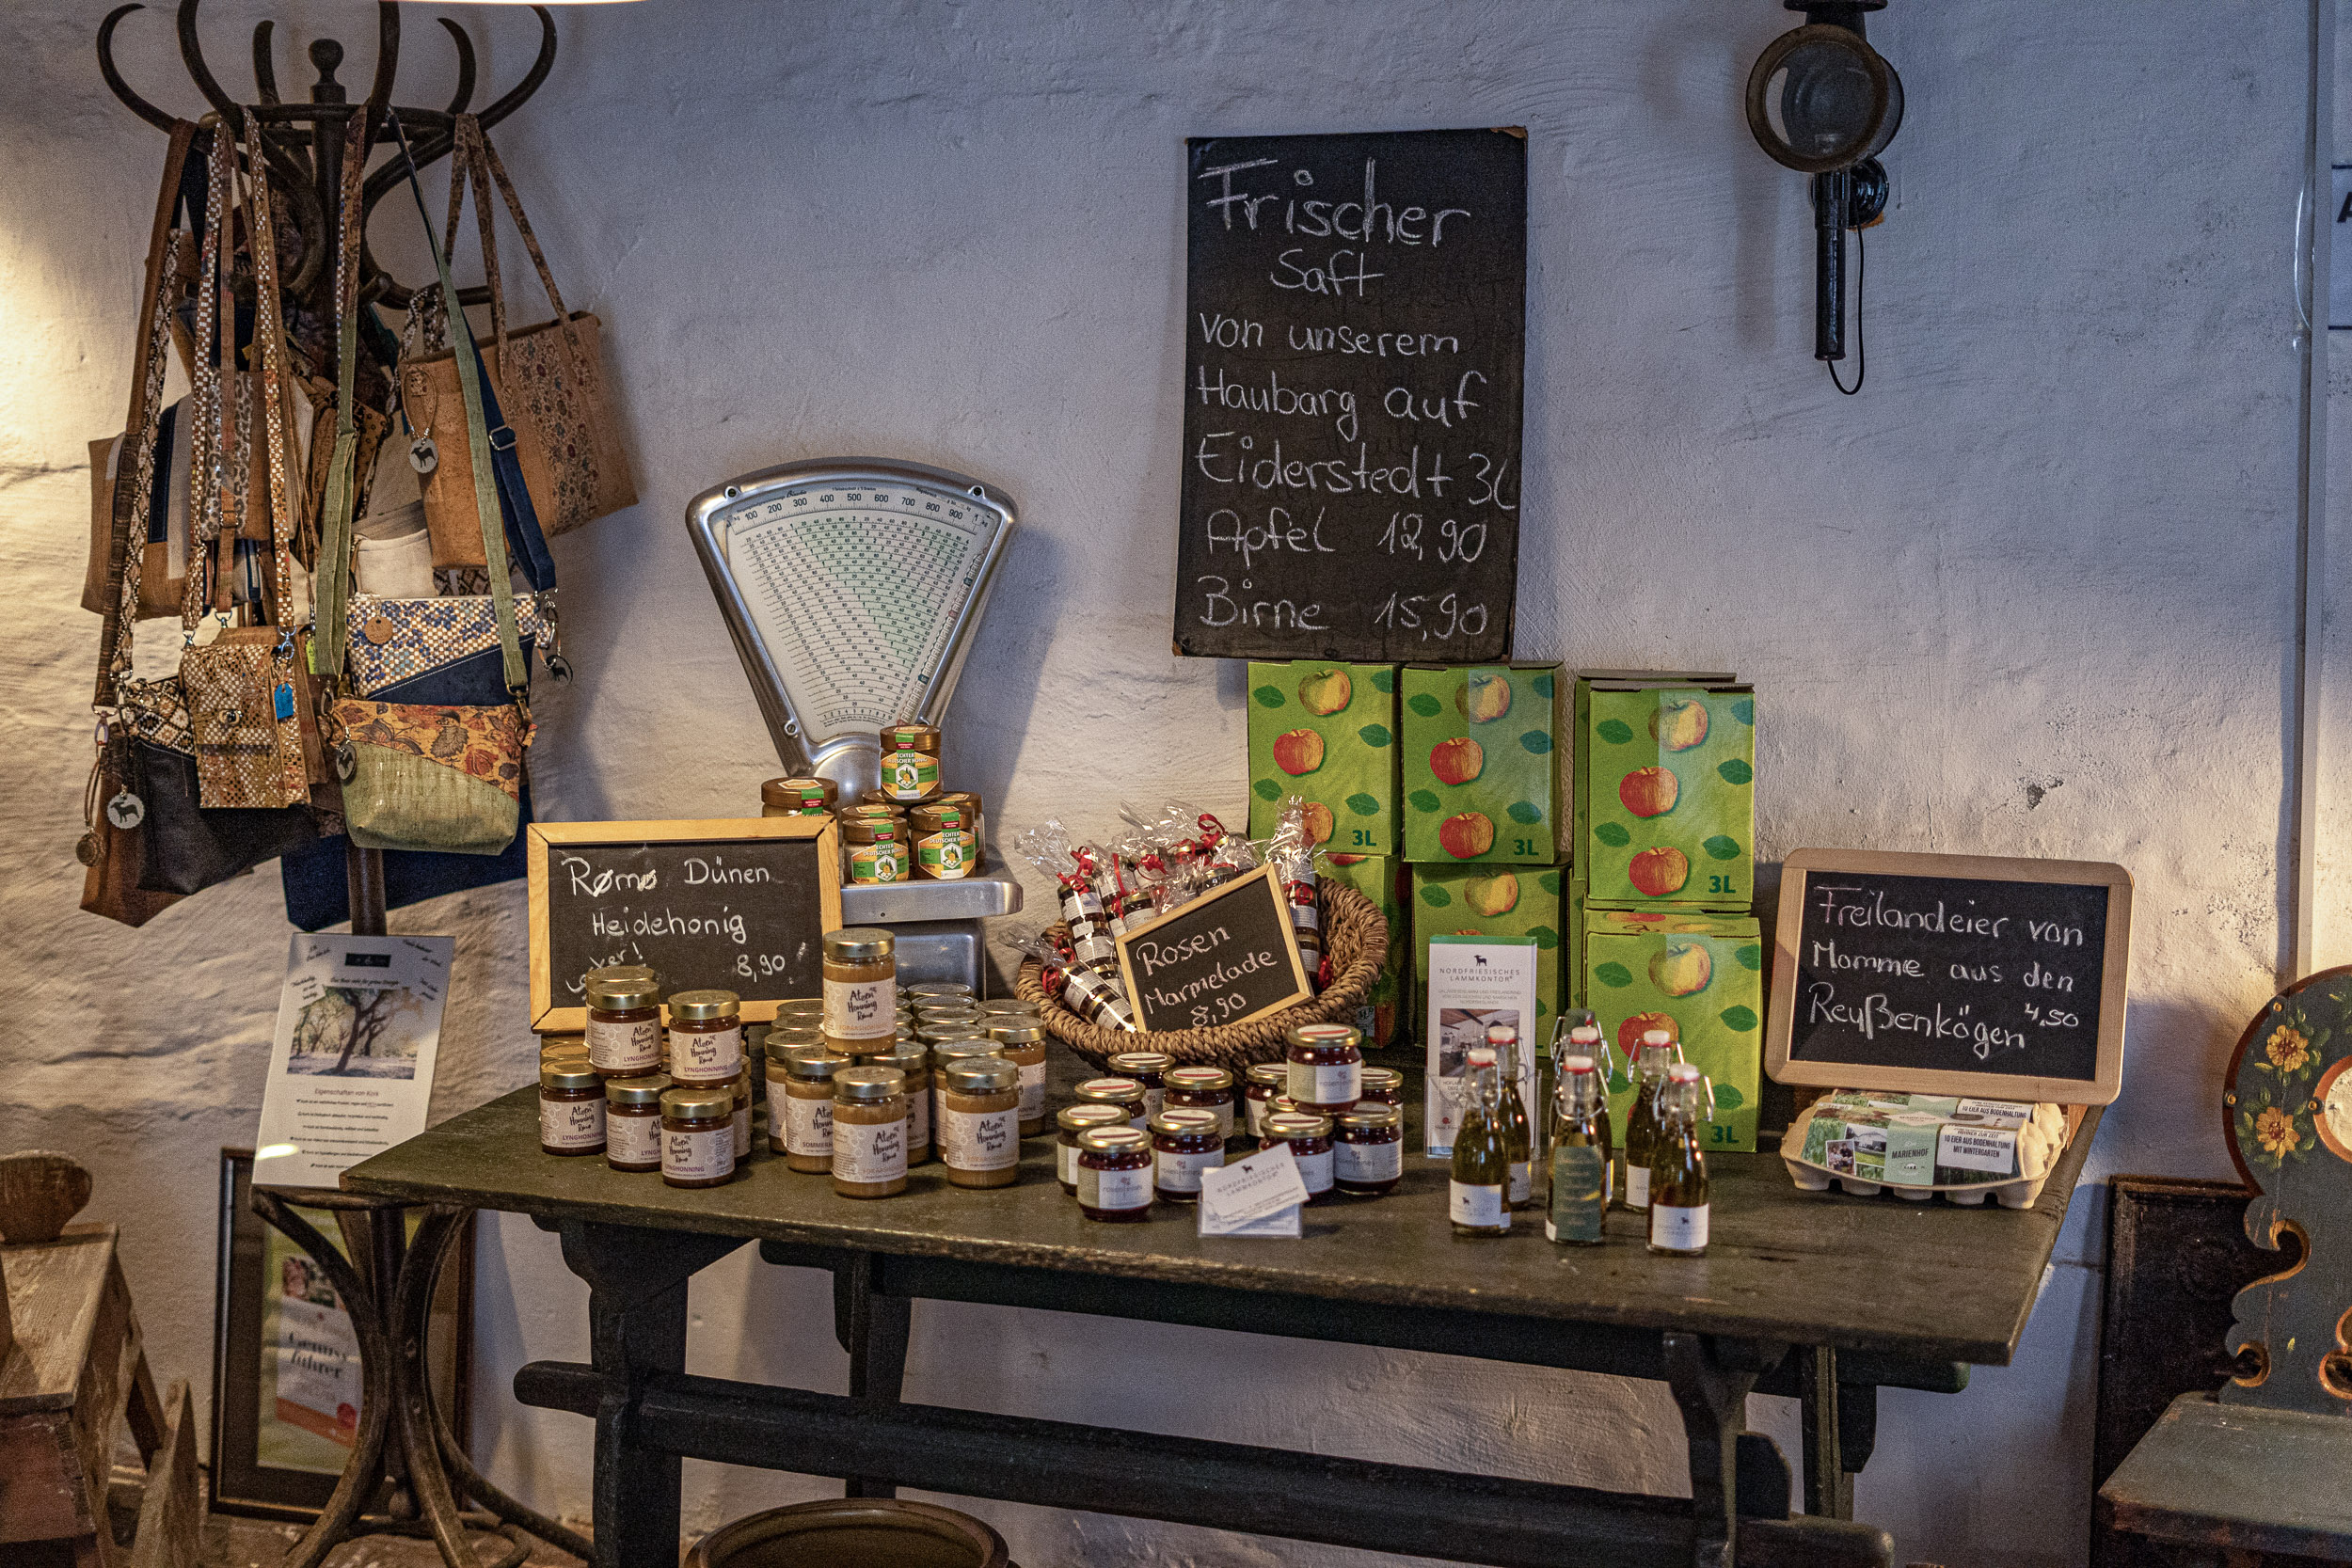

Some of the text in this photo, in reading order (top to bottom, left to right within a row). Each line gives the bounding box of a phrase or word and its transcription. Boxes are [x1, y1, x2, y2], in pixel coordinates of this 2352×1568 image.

[1198, 156, 1471, 247] Frischer
[1270, 248, 1386, 296] Saft
[1200, 312, 1458, 357] von unserem
[1198, 365, 1487, 443] Haubarg auf
[1194, 431, 1454, 499] Eiderstedt
[744, 510, 758, 521] 100
[768, 502, 783, 515] 200
[792, 497, 808, 508] 300
[819, 494, 834, 503] 400
[847, 493, 862, 501] 500
[874, 494, 889, 503] 600
[901, 497, 915, 507] 700
[925, 501, 941, 513] 800
[948, 508, 963, 520] 900
[1207, 507, 1336, 569] Apfel
[1198, 576, 1331, 631] Birne
[1352, 829, 1377, 847] 3L
[1514, 839, 1539, 857] 3L
[683, 856, 771, 886] Dünen
[1708, 876, 1737, 894] 3L
[592, 906, 748, 944] Heidehonig
[1813, 885, 2084, 948] Freilandeier von
[737, 953, 787, 983] 8,90
[1136, 926, 1232, 977] Rosen
[1812, 938, 2074, 992] Momme aus den
[1144, 950, 1279, 1015] Marmelade
[1439, 967, 1520, 975] NORDFRIESISCHES
[1190, 992, 1247, 1027] 8,90
[684, 1064, 728, 1072] LYNGHONNING
[1990, 1108, 2026, 1118] BODENHALTUNG
[1892, 1148, 1930, 1159] MARIENHOF
[1951, 1135, 1963, 1144] EIER
[1963, 1136, 1973, 1146] AUS
[1973, 1137, 2011, 1149] BODENHALTUNG
[1953, 1146, 2000, 1158] MIT WINTERGARTEN
